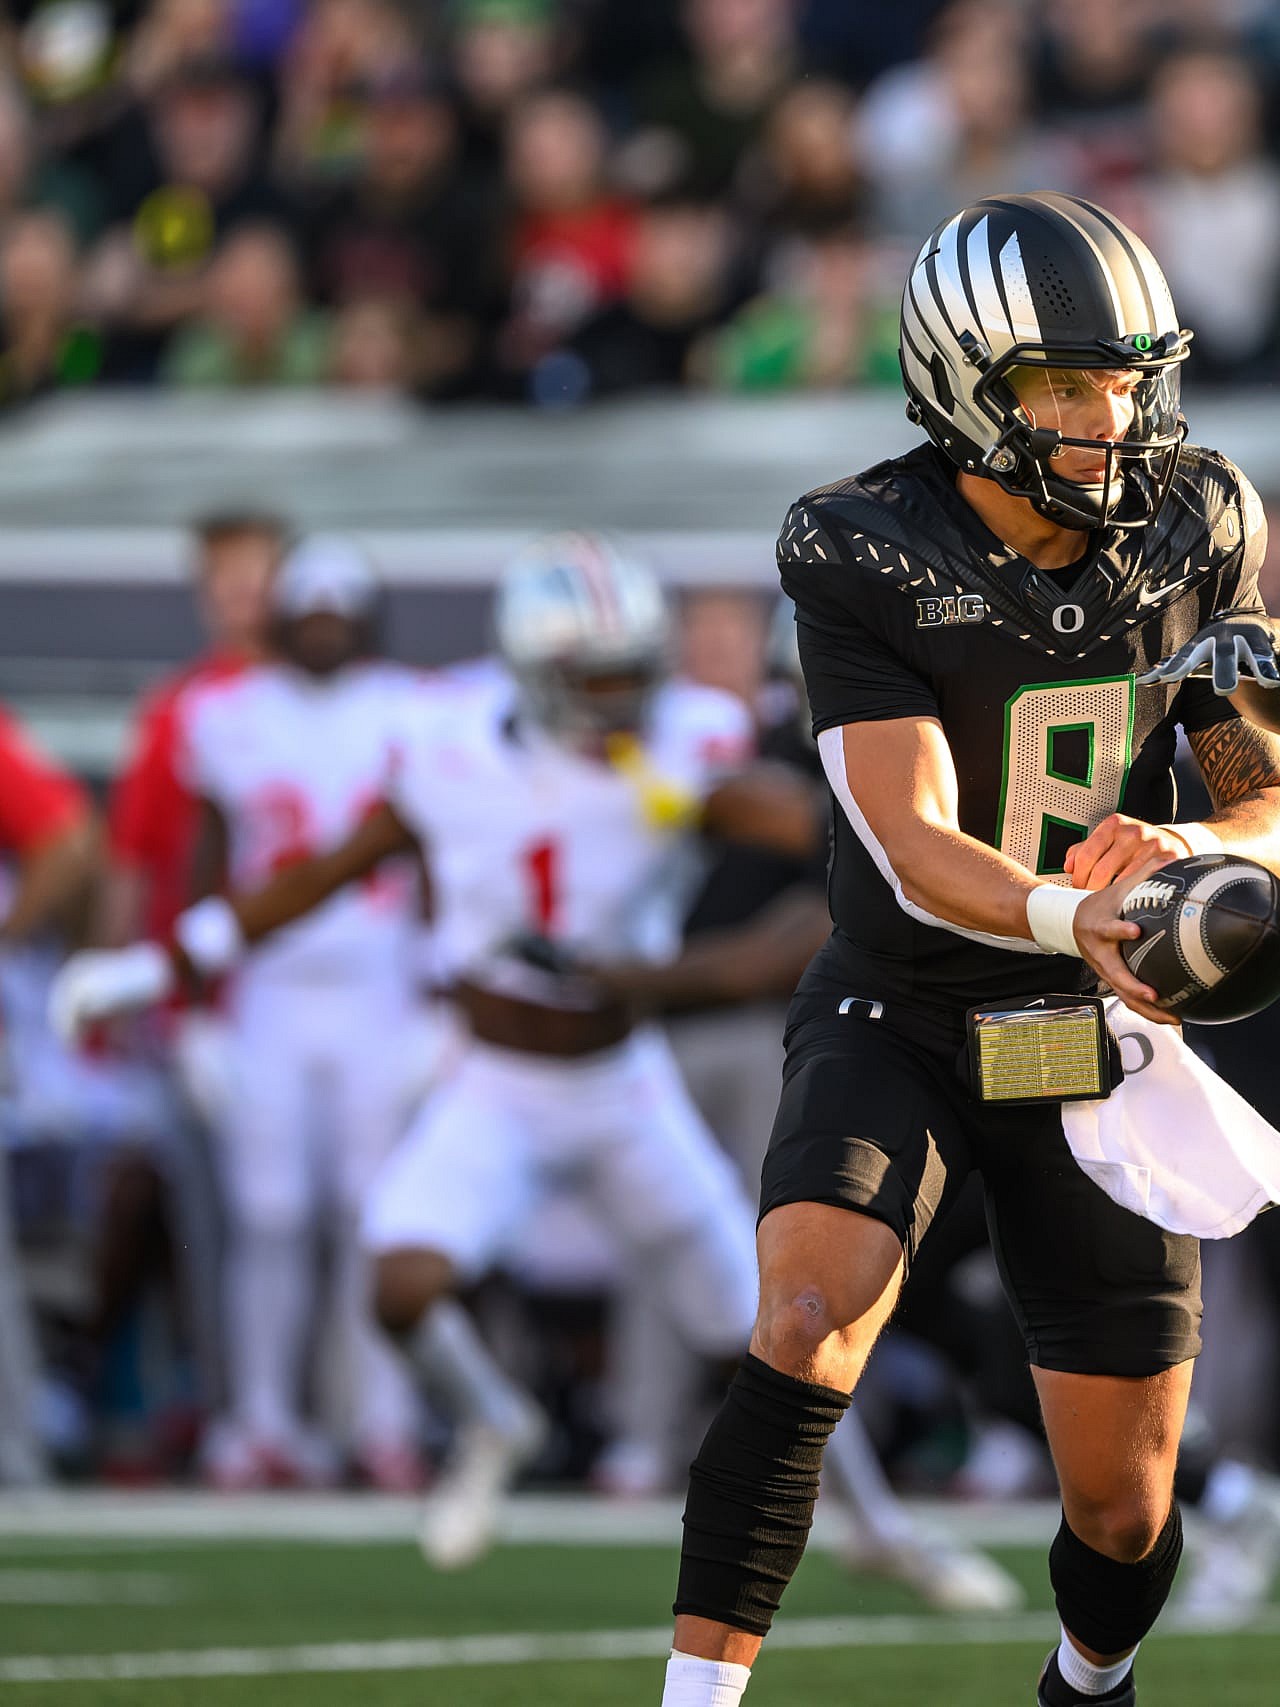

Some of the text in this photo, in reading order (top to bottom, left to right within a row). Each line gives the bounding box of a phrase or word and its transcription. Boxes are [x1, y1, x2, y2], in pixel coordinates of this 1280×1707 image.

[1135, 334, 1152, 351] O
[1052, 604, 1086, 634] O
[994, 672, 1137, 890] 8
